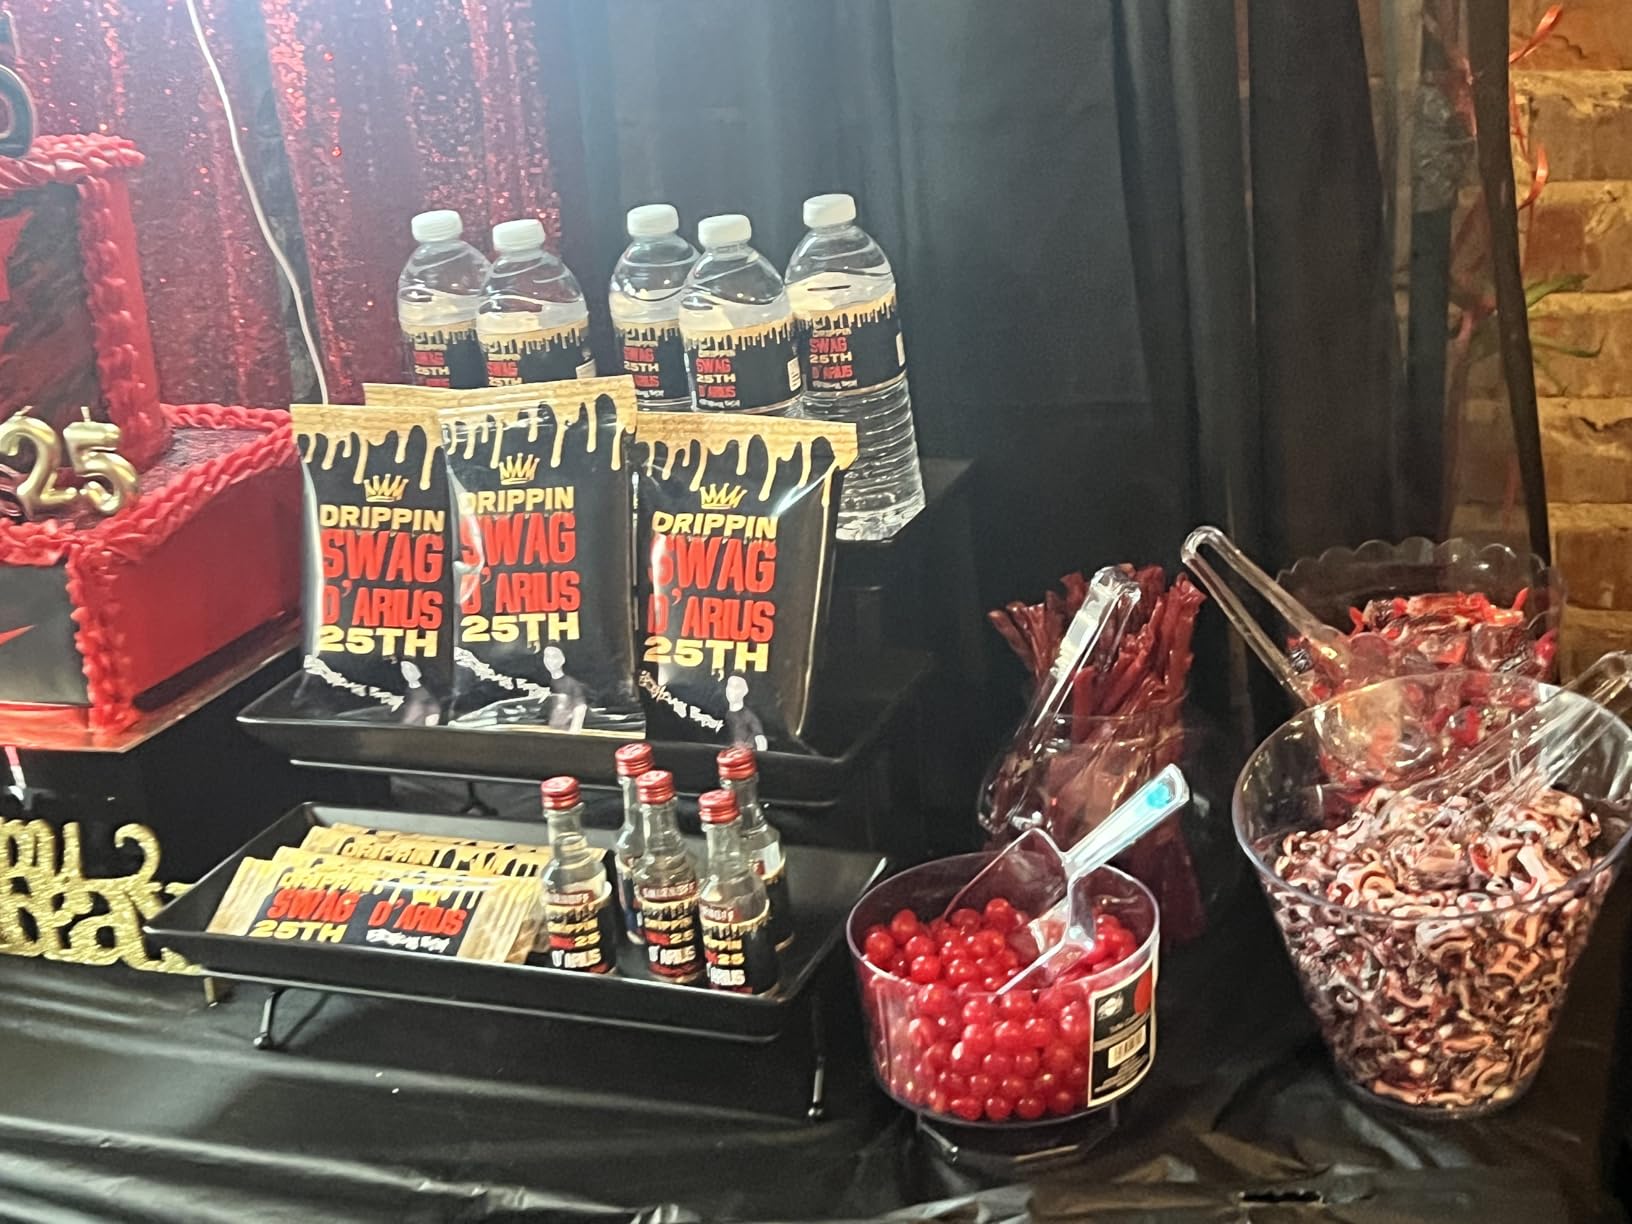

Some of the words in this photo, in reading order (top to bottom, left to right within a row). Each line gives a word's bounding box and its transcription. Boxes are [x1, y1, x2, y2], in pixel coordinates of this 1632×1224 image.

[623, 361, 659, 372] 25TH
[809, 352, 852, 363] 25TH
[696, 374, 736, 383] 25TH
[459, 486, 575, 514] DRIPPIN
[319, 504, 446, 532] DRIPPIN
[652, 511, 778, 539] DRIPPIN
[460, 511, 576, 566] SWAG
[320, 528, 445, 583] SWAG
[648, 534, 777, 593] SWAG
[322, 579, 443, 629] D'ARIUS
[319, 625, 438, 657] 25TH
[460, 611, 580, 642] 25TH
[643, 636, 769, 672] 25TH
[267, 888, 361, 923] SWAG
[367, 898, 467, 935] D'ARIUS
[248, 919, 349, 943] 25TH
